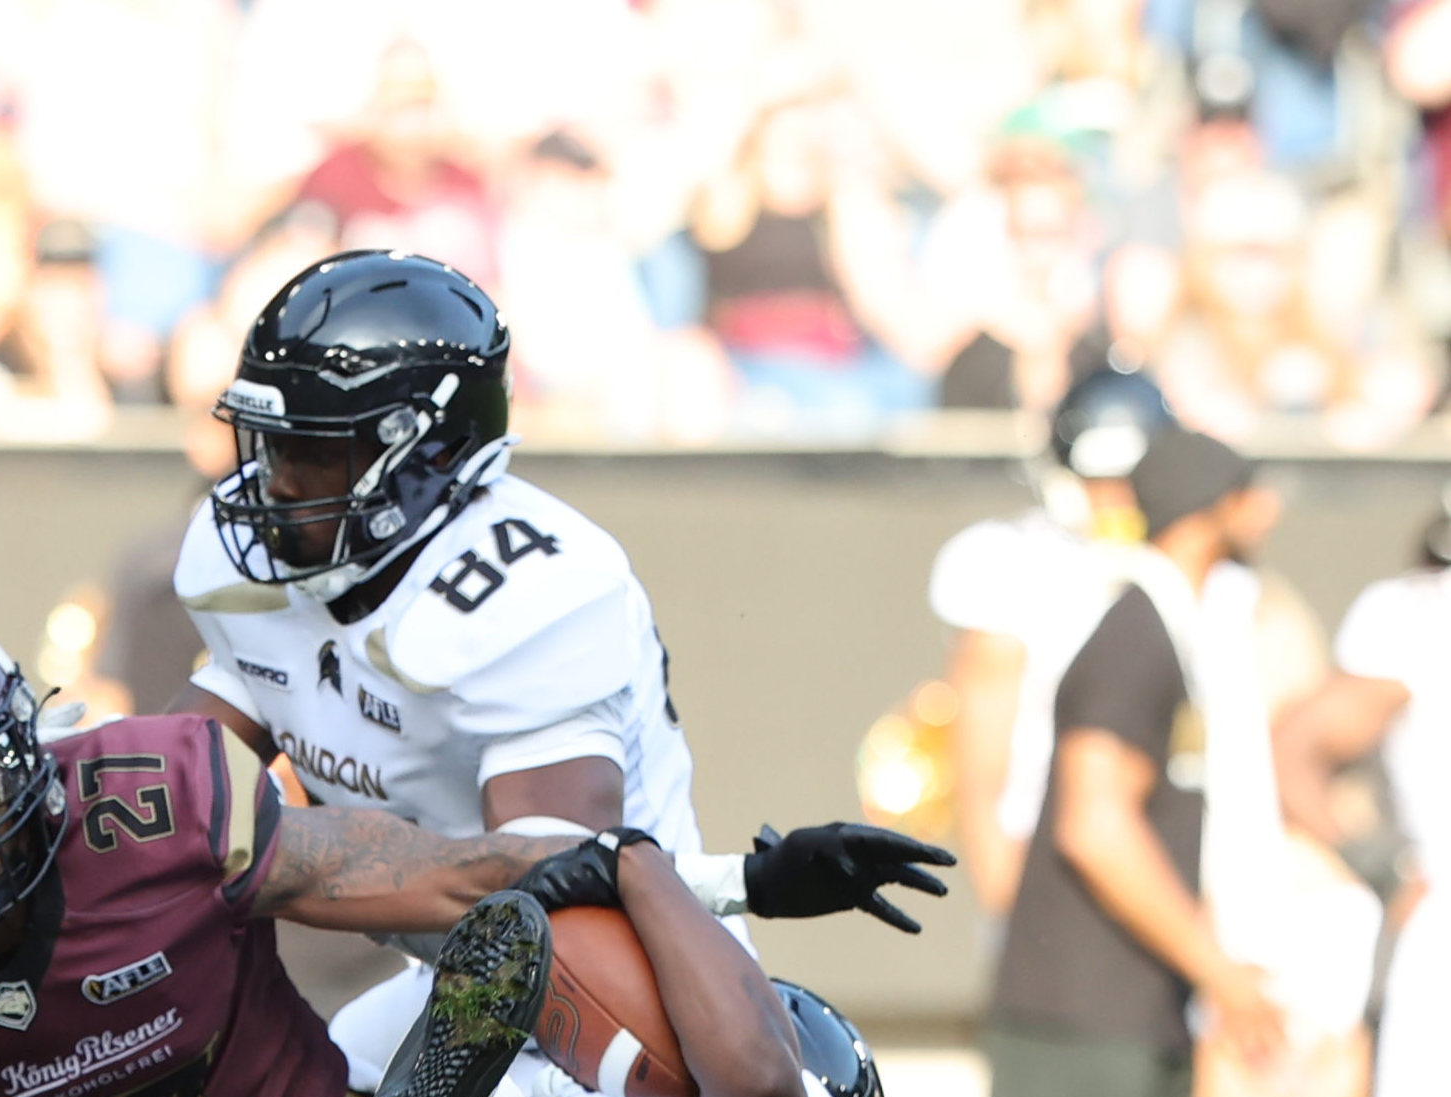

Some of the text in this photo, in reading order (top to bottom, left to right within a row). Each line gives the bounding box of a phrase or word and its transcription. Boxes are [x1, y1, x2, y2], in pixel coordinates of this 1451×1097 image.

[428, 518, 562, 614] 84
[77, 754, 175, 853] 27
[279, 731, 388, 801] ONDON
[101, 955, 167, 999] AFLE
